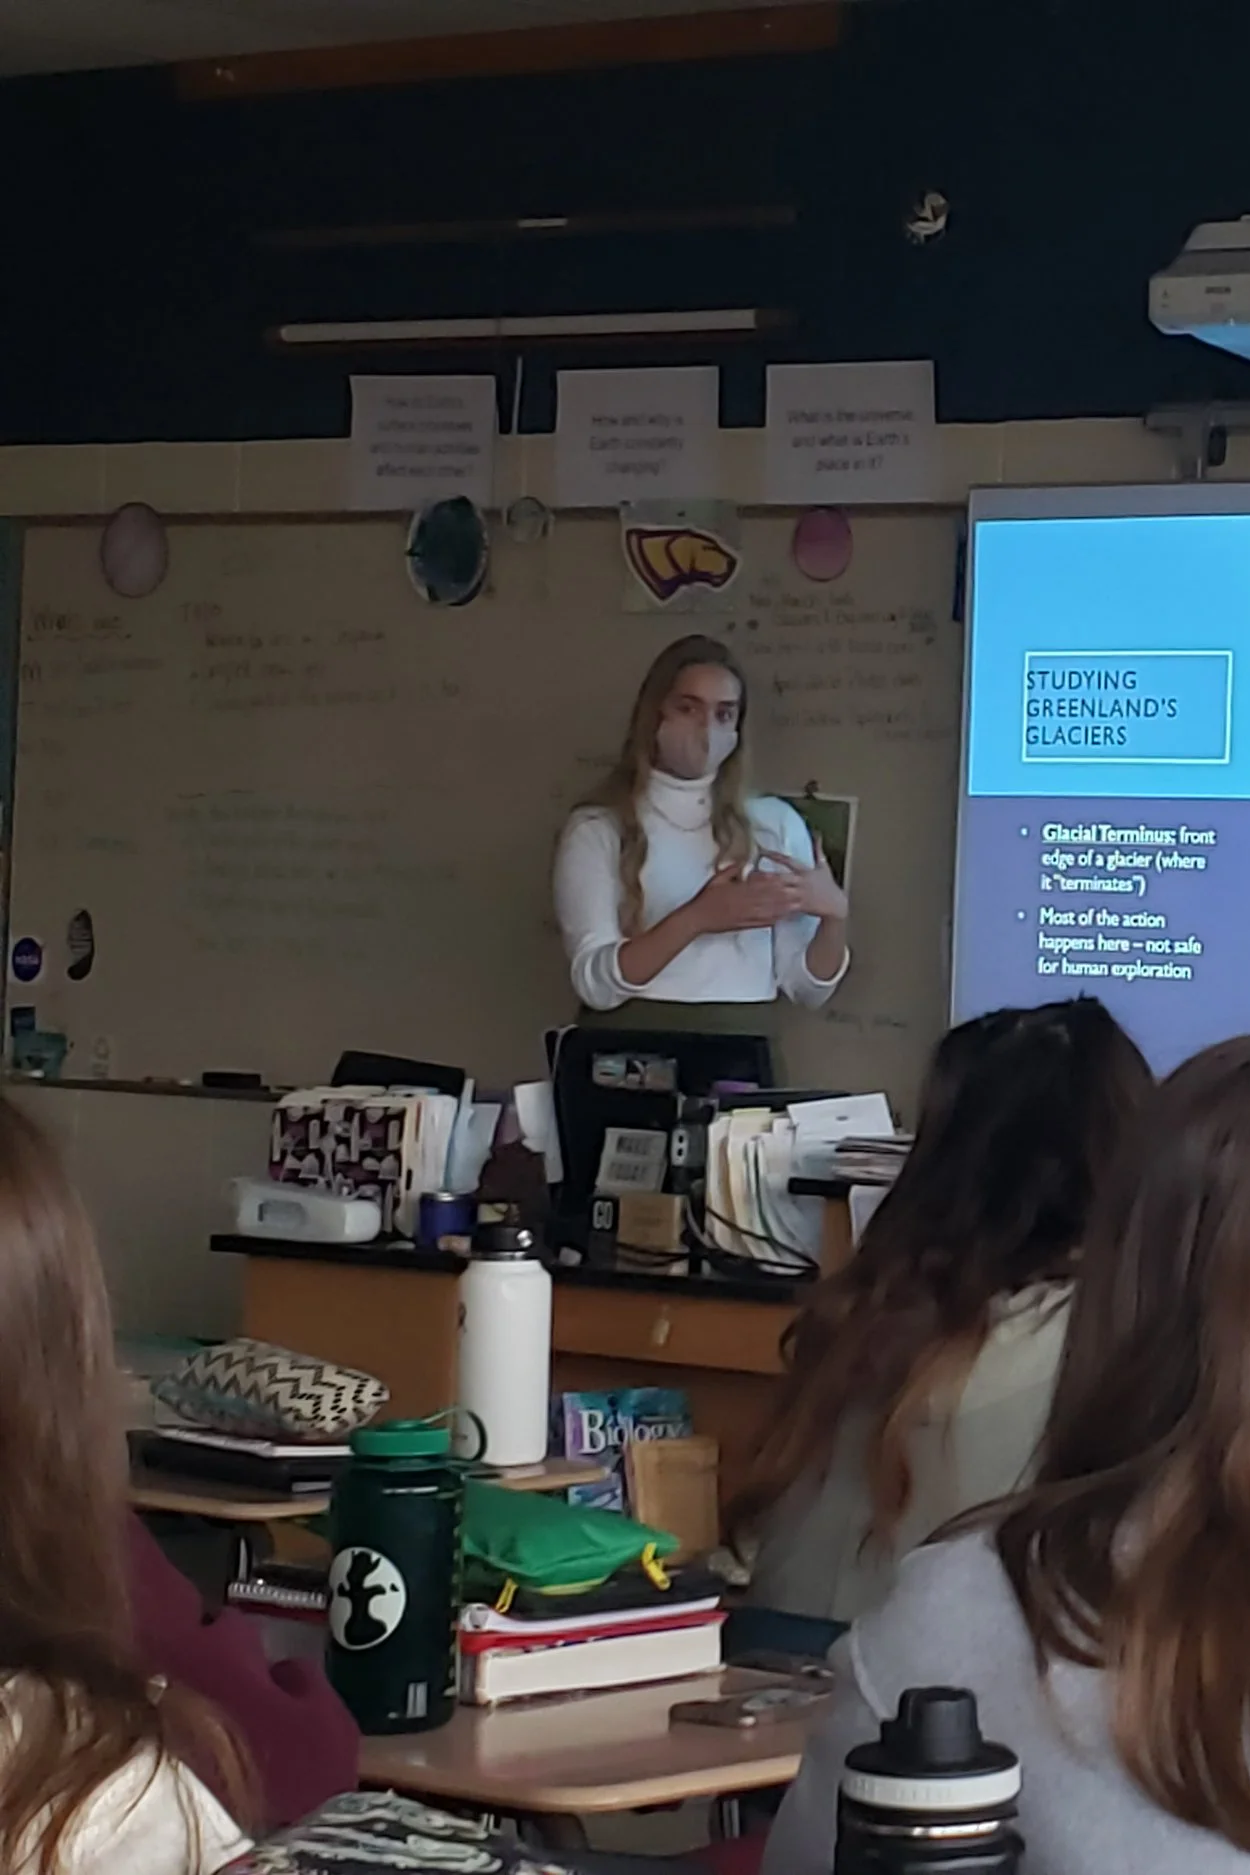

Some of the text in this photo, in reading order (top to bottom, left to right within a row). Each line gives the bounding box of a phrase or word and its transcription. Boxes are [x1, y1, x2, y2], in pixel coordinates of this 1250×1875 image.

[1026, 670, 1137, 690] STUDYING
[1026, 698, 1178, 718] GREENLAND'S
[1026, 726, 1127, 746] GLACIERS
[1042, 824, 1097, 843] Glacial
[1179, 826, 1216, 845] front
[1042, 848, 1206, 873] edge of a glacier (where
[1041, 874, 1051, 890] it
[1040, 907, 1165, 928] Most of the action
[1038, 931, 1094, 954] happens
[1097, 932, 1130, 951] here
[1146, 940, 1170, 953] not
[1174, 936, 1202, 955] safe
[1038, 957, 1192, 981] for human exploration
[577, 1407, 685, 1454] Biology
